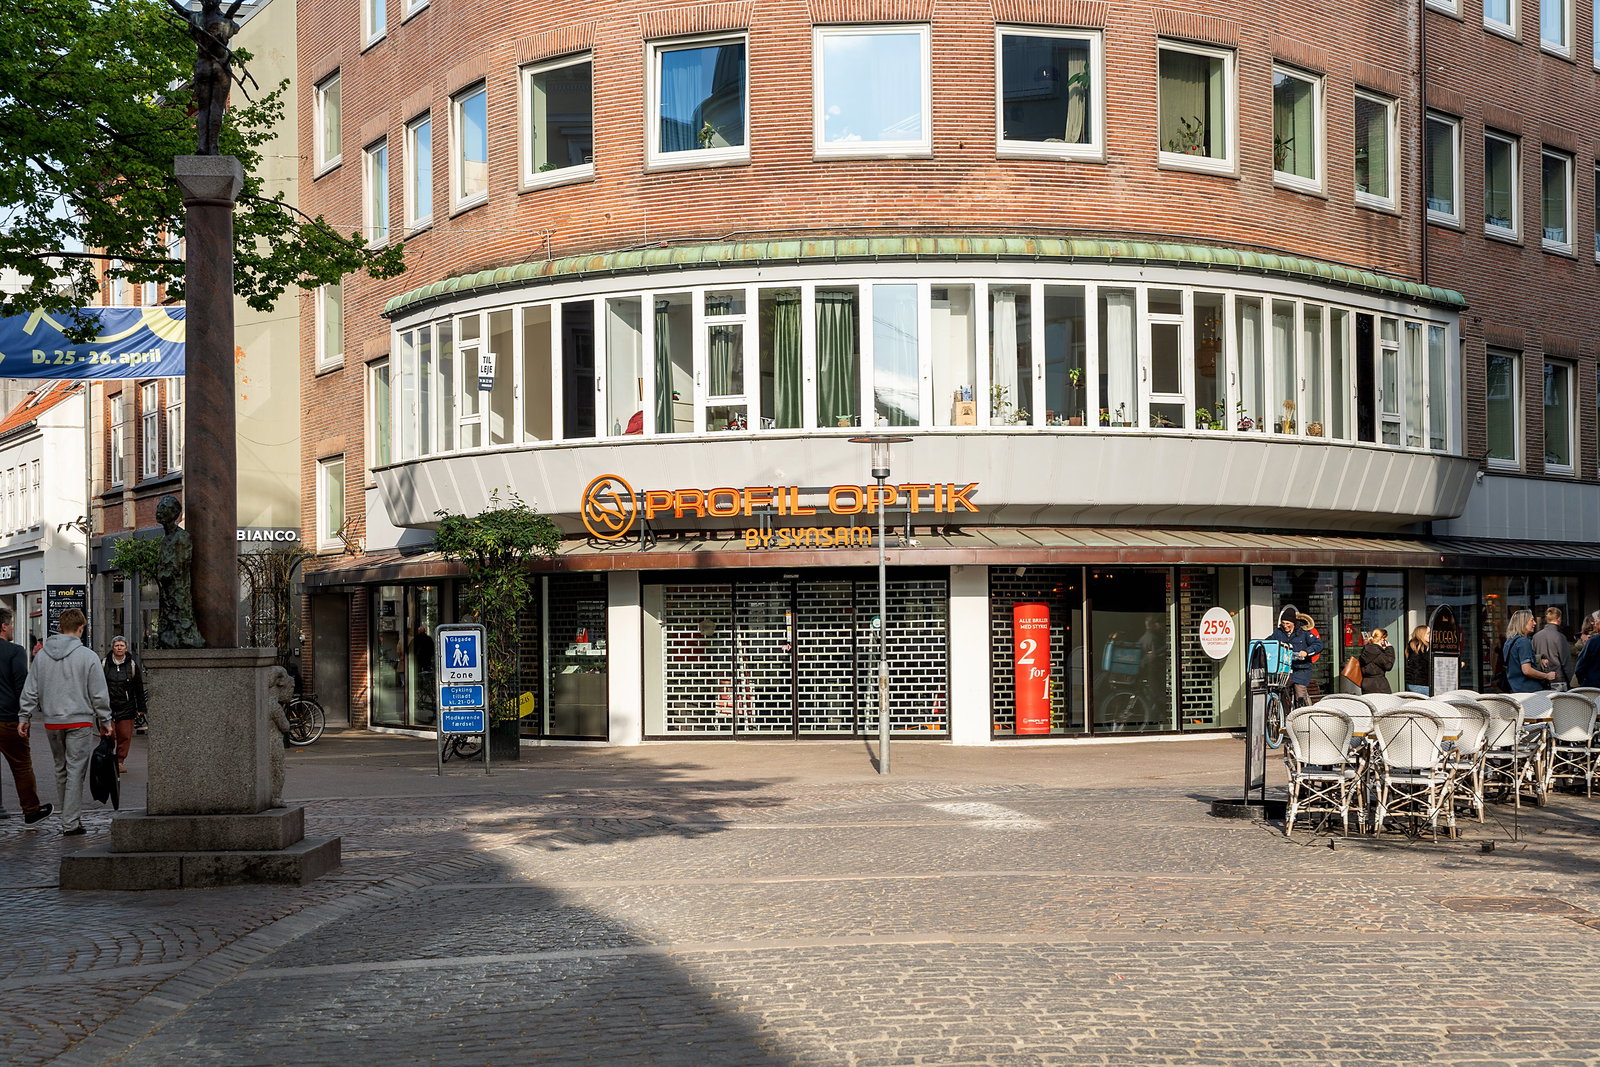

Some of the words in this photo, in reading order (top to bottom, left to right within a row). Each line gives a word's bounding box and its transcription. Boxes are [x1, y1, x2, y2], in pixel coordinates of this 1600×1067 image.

[32, 350, 50, 364] D.
[54, 350, 76, 365] 25
[89, 351, 117, 365] 26.
[120, 348, 162, 367] april
[483, 356, 491, 364] TIL
[480, 366, 492, 375] LEJE
[646, 486, 816, 519] PROFIL
[828, 482, 980, 515] OPTIK
[237, 529, 301, 541] BIANCO.
[746, 528, 772, 547] BY
[778, 526, 873, 548] SYNSAM
[1017, 639, 1037, 664] 2
[450, 671, 473, 679] Zone
[1029, 667, 1045, 680] for
[1041, 674, 1050, 699] 1
